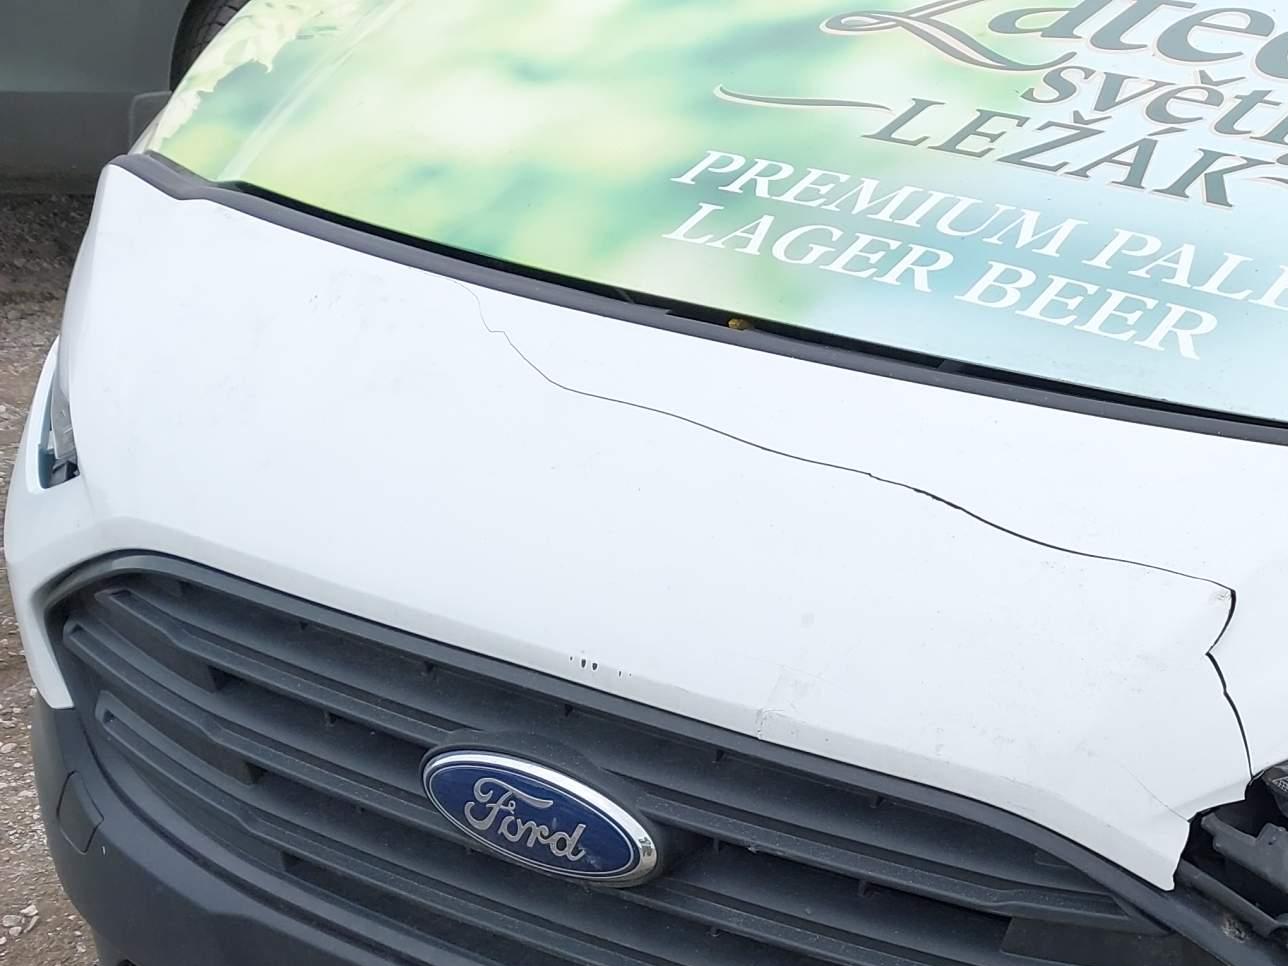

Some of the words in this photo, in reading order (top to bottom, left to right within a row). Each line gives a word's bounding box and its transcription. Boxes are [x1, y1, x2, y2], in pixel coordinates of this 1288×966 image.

[670, 149, 1088, 257] PREMIUM
[861, 97, 1276, 208] LEŽÁK
[661, 202, 954, 293] LAGER
[953, 260, 1218, 360] BEER
[463, 777, 587, 862] Ford
